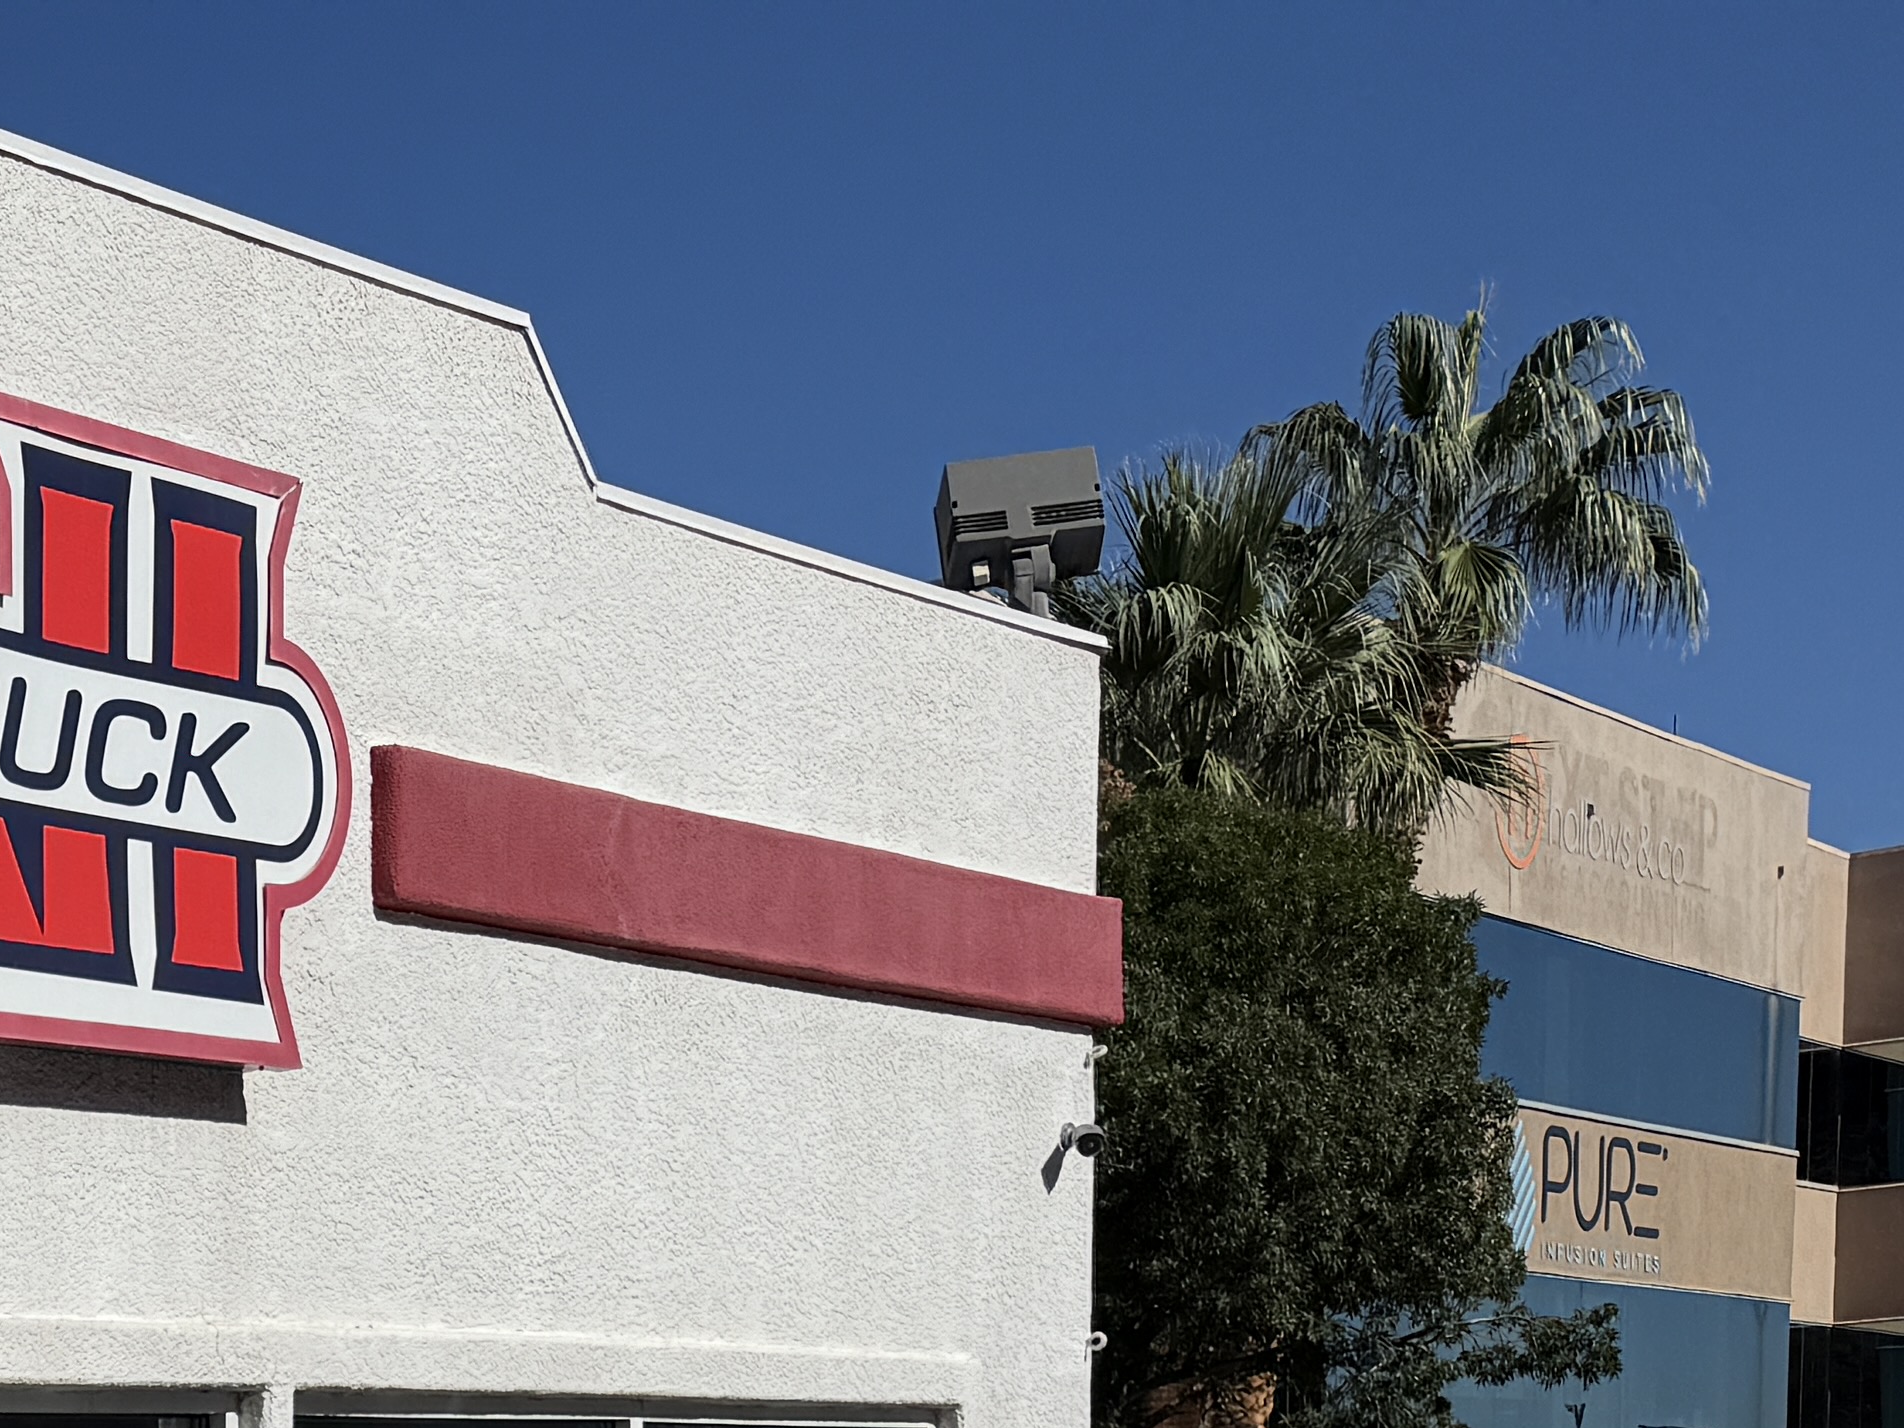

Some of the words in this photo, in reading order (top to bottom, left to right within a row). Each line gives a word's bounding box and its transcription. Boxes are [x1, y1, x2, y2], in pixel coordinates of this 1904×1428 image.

[1541, 1124, 1661, 1240] PURE
[1539, 1240, 1607, 1268] INFUSION
[1612, 1249, 1662, 1276] SUITES
